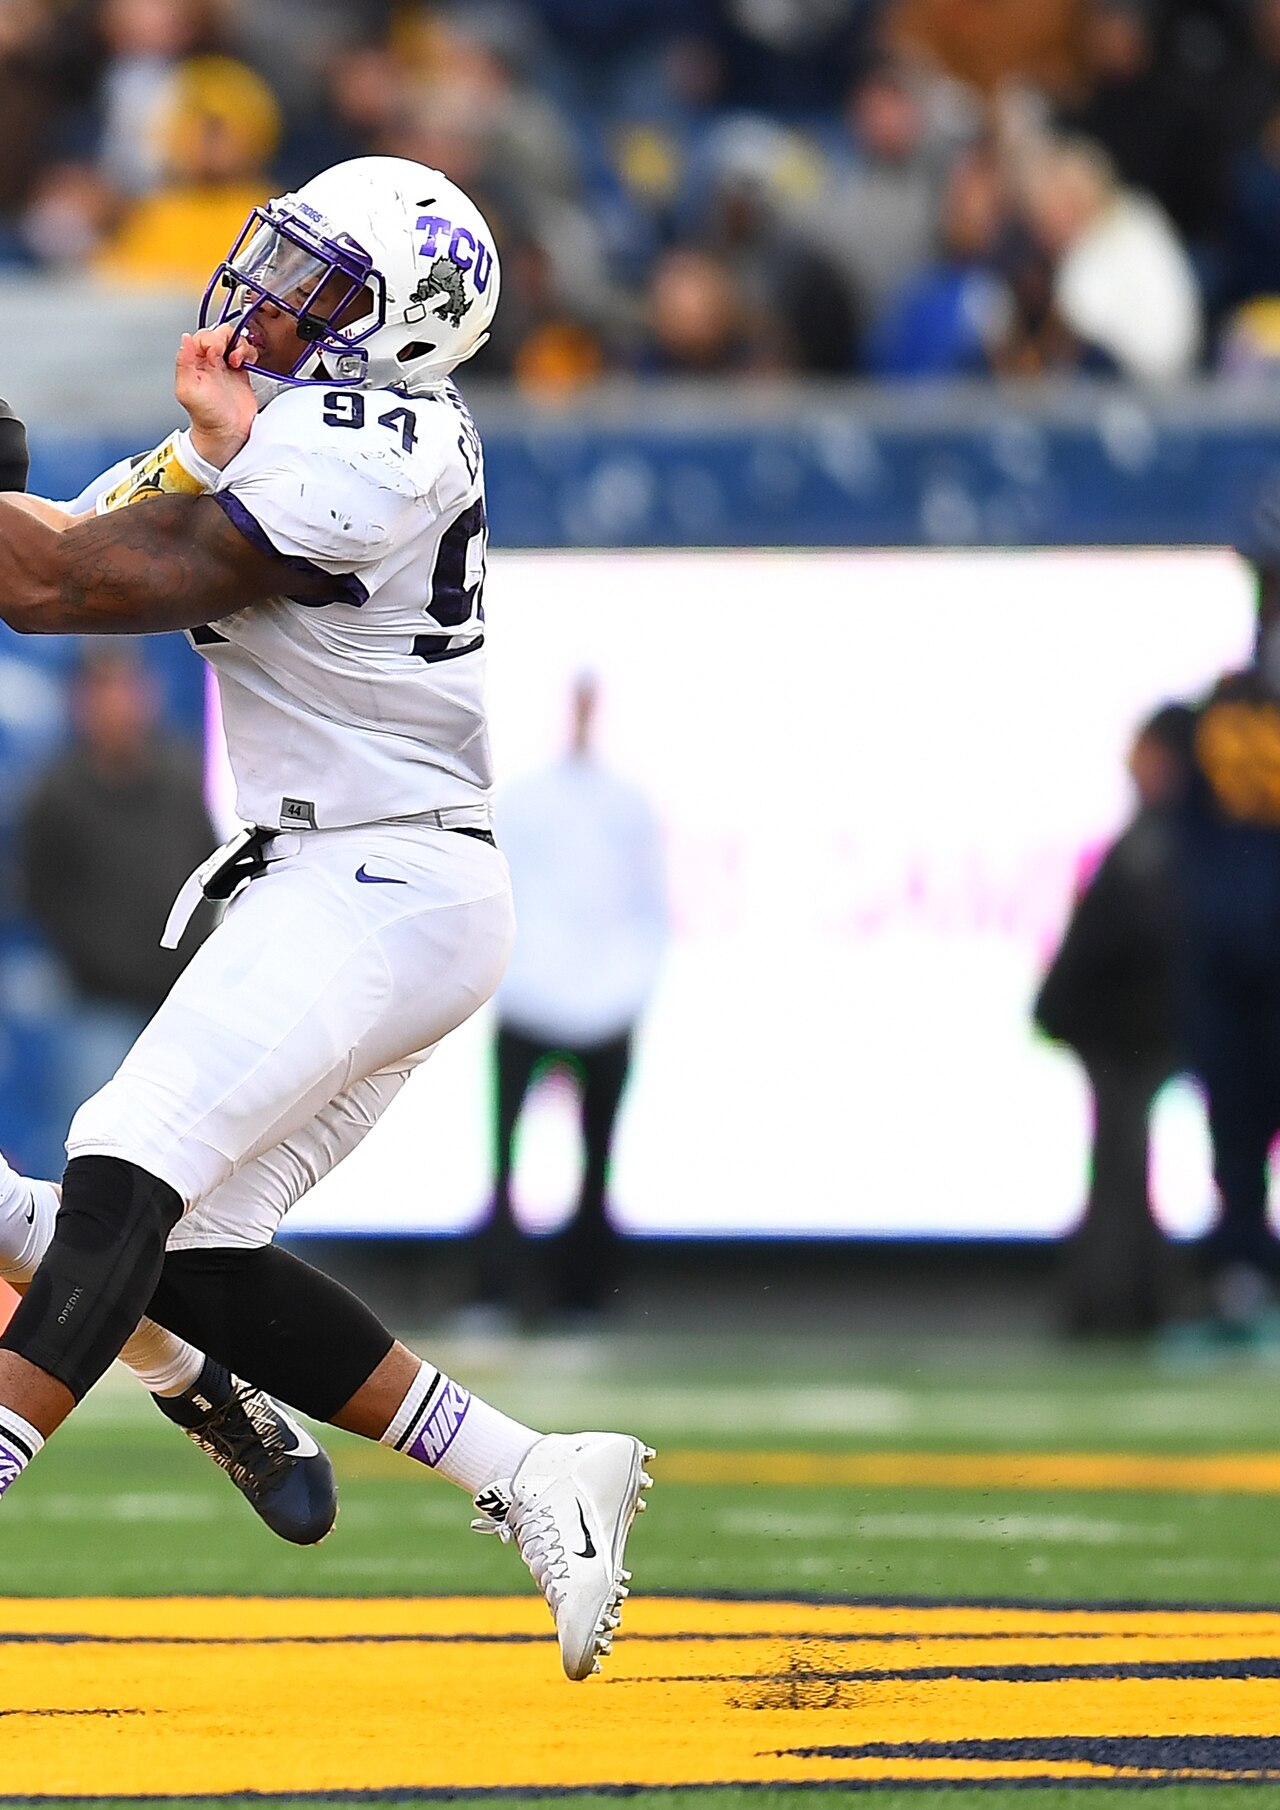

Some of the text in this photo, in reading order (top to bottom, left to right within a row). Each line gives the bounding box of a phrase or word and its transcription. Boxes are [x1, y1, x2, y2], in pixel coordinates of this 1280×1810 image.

[415, 215, 493, 294] TCU
[322, 391, 419, 455] 94
[287, 804, 301, 816] 44
[57, 1286, 83, 1324] OPEDIX
[420, 1380, 470, 1465] NIK
